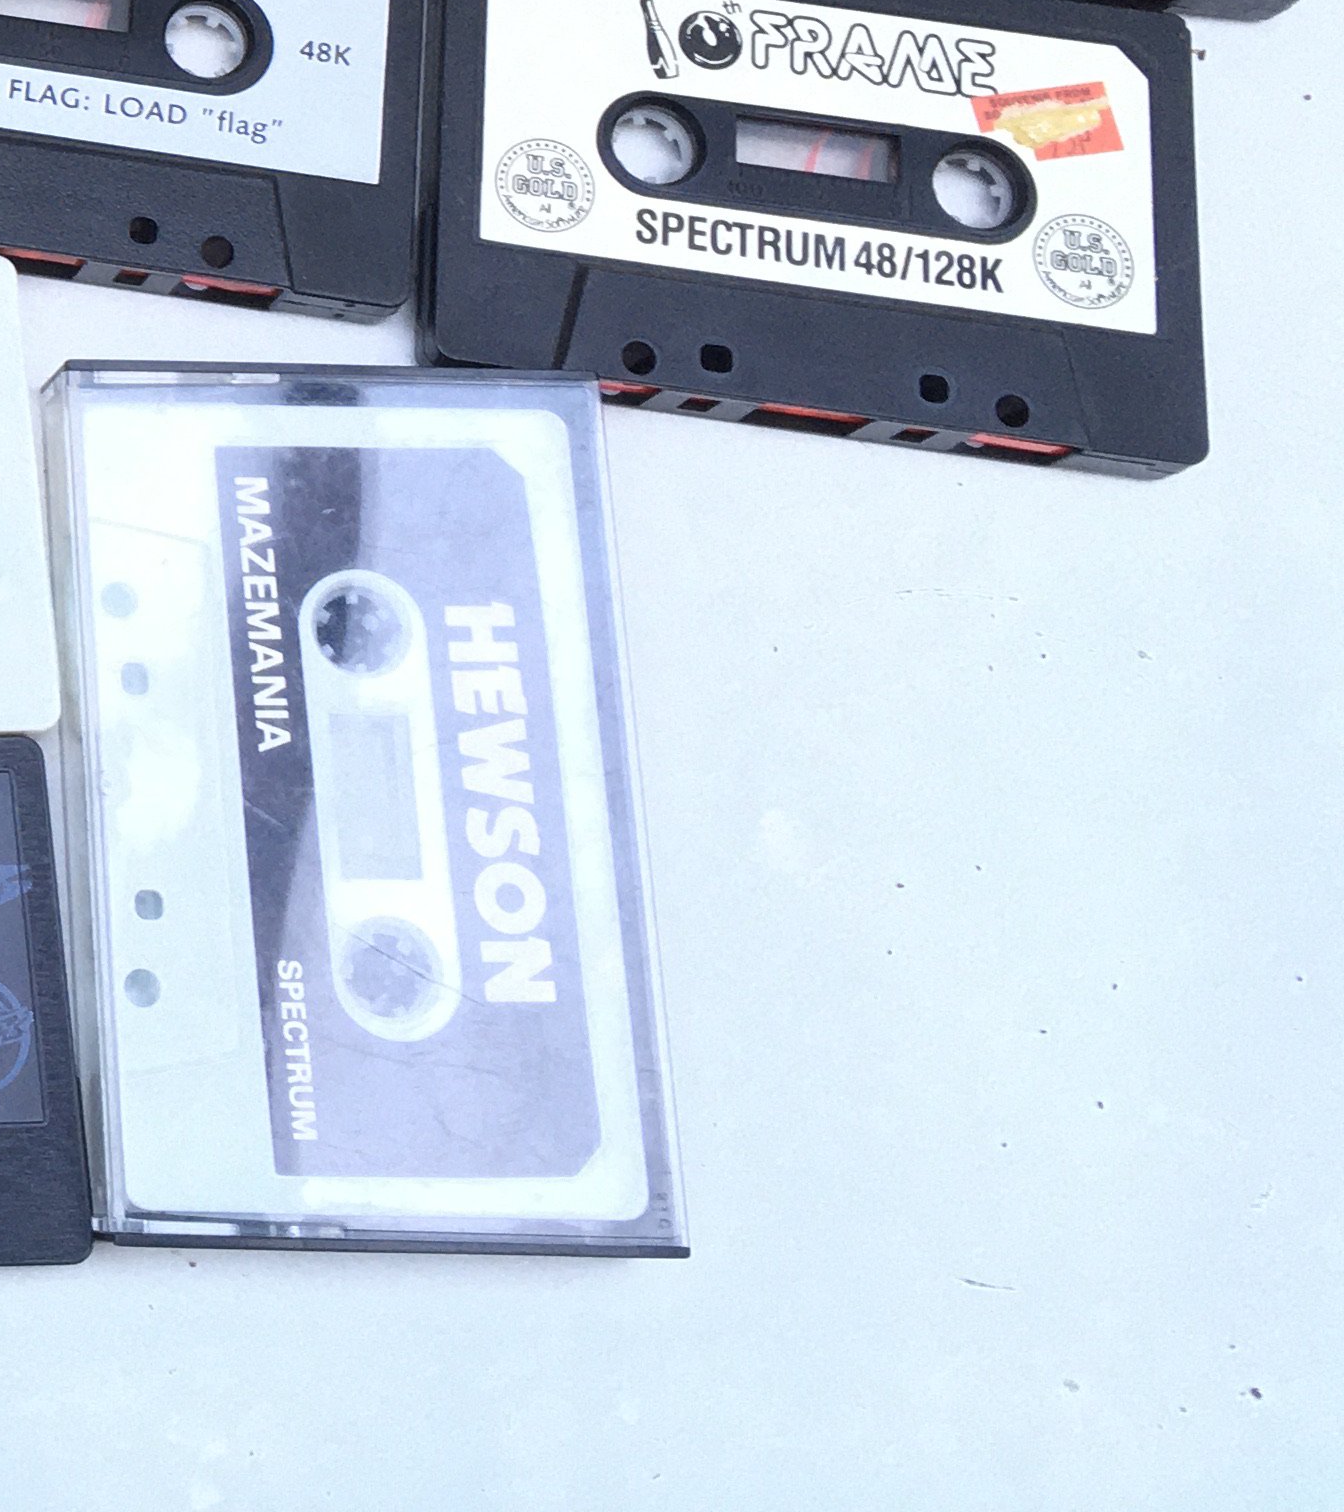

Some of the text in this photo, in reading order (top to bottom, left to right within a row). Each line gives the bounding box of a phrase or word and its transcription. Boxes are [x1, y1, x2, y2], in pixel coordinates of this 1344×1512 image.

[299, 41, 350, 66] 48K
[751, 10, 997, 97] FRAME
[9, 78, 91, 112] FLAG:
[103, 93, 187, 126] LOAD
[513, 175, 579, 201] GOLD
[527, 153, 571, 177] U.S.
[635, 209, 1004, 294] SPECTRUM 48/128K
[234, 476, 293, 753] MAZEMANIA
[444, 601, 557, 1003] HEWSON
[276, 959, 317, 1142] SPECTRUM
